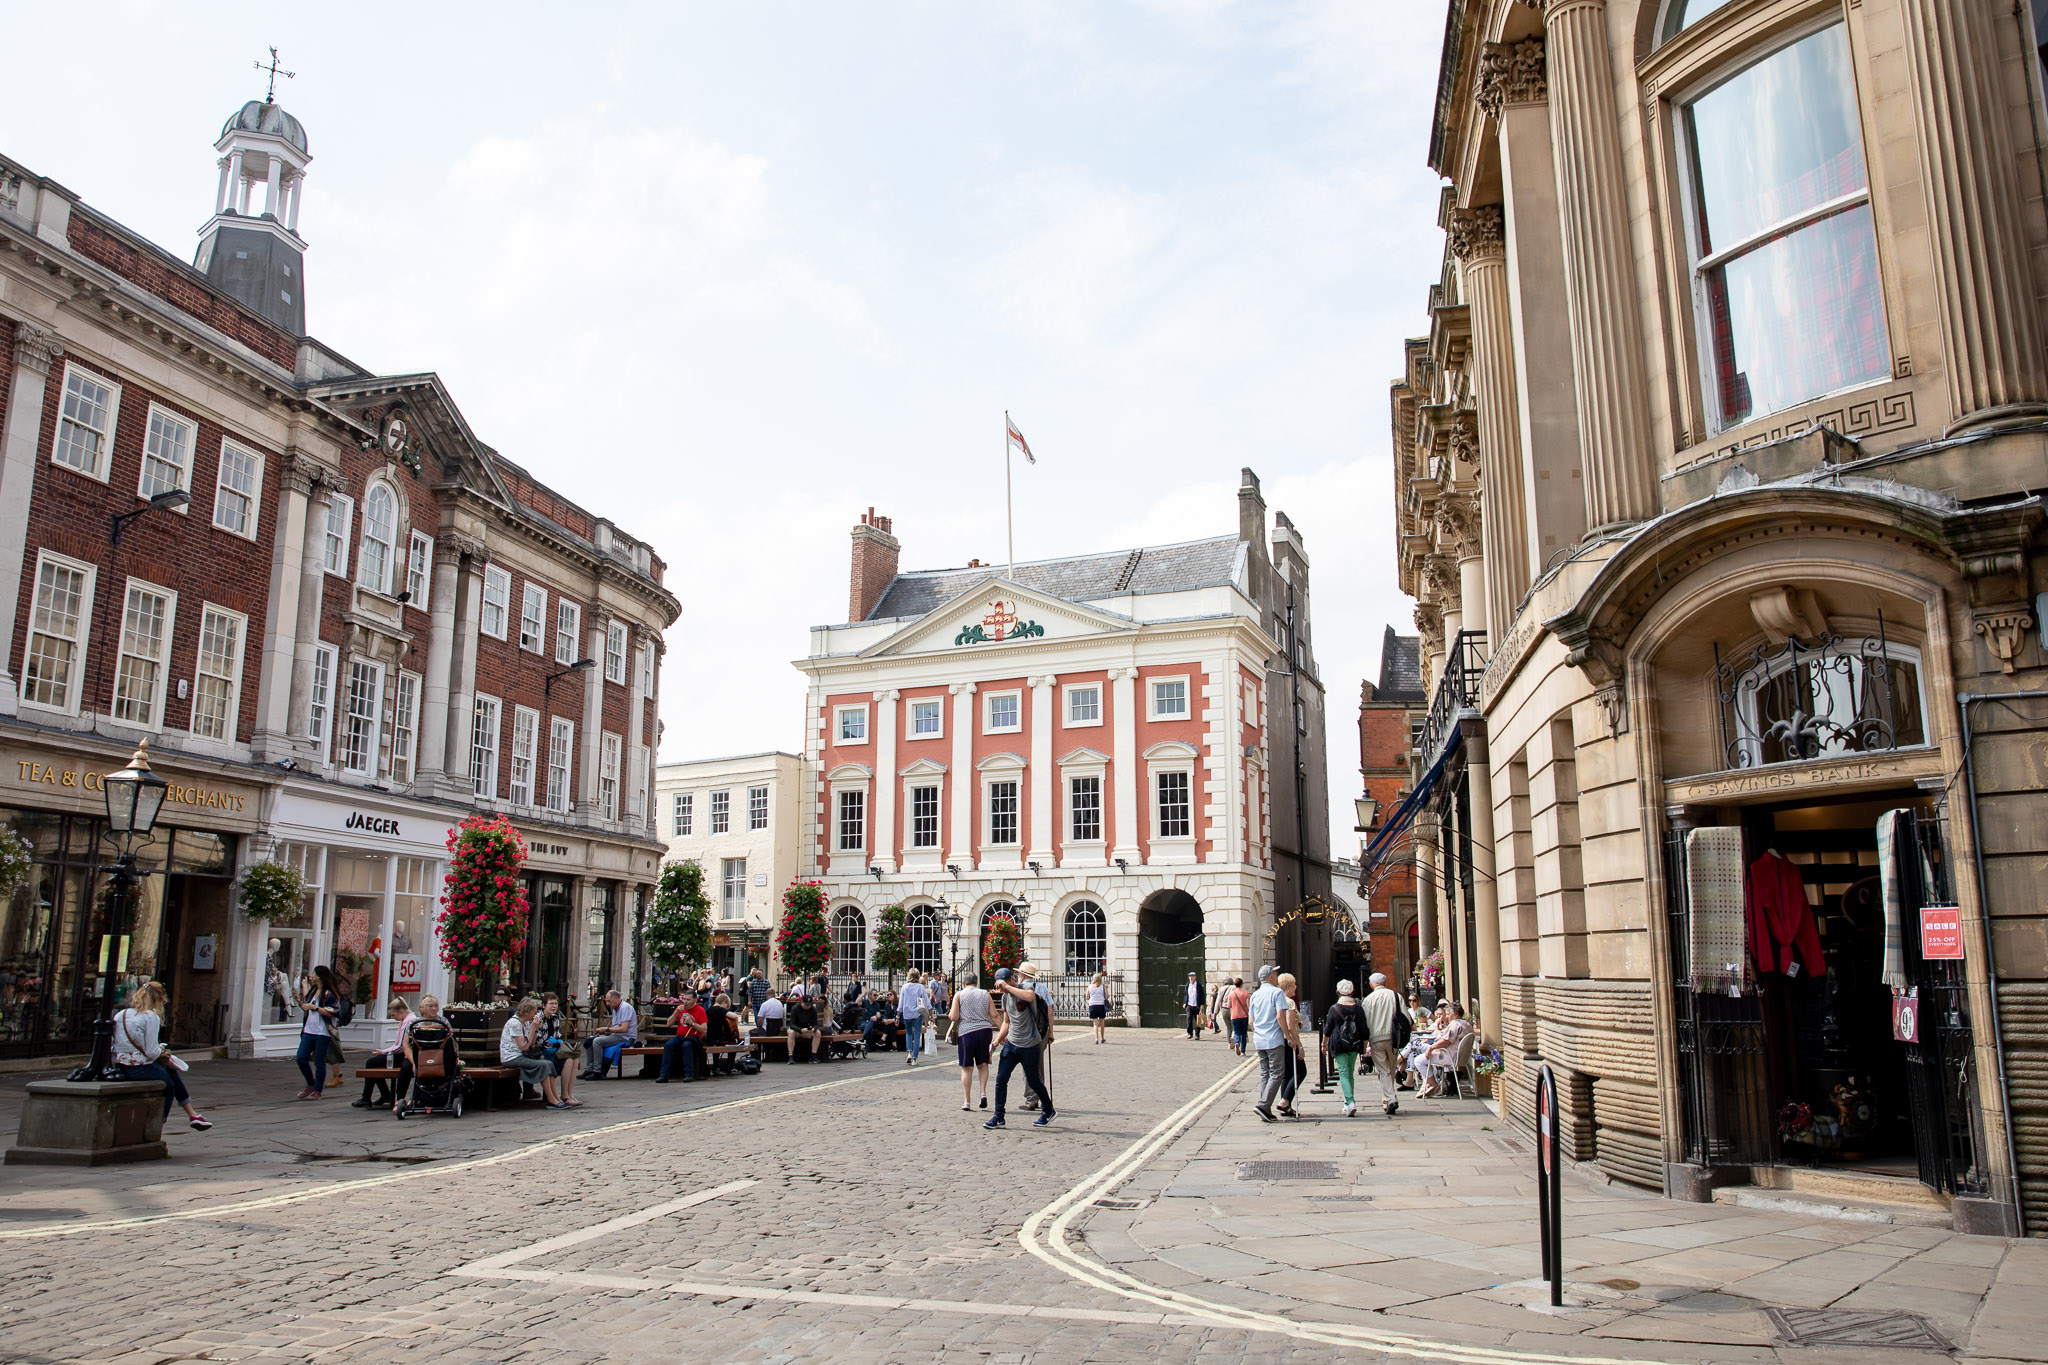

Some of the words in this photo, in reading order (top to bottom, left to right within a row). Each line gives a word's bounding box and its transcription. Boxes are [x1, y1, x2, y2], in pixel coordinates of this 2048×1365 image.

[18, 760, 55, 784] TEA
[62, 770, 77, 787] &
[1708, 773, 1795, 796] SAVINGS
[1808, 763, 1880, 784] BANK
[346, 811, 400, 836] JAEGER
[530, 841, 549, 854] THE
[551, 844, 569, 856] IVY
[1926, 922, 1957, 930] SALE
